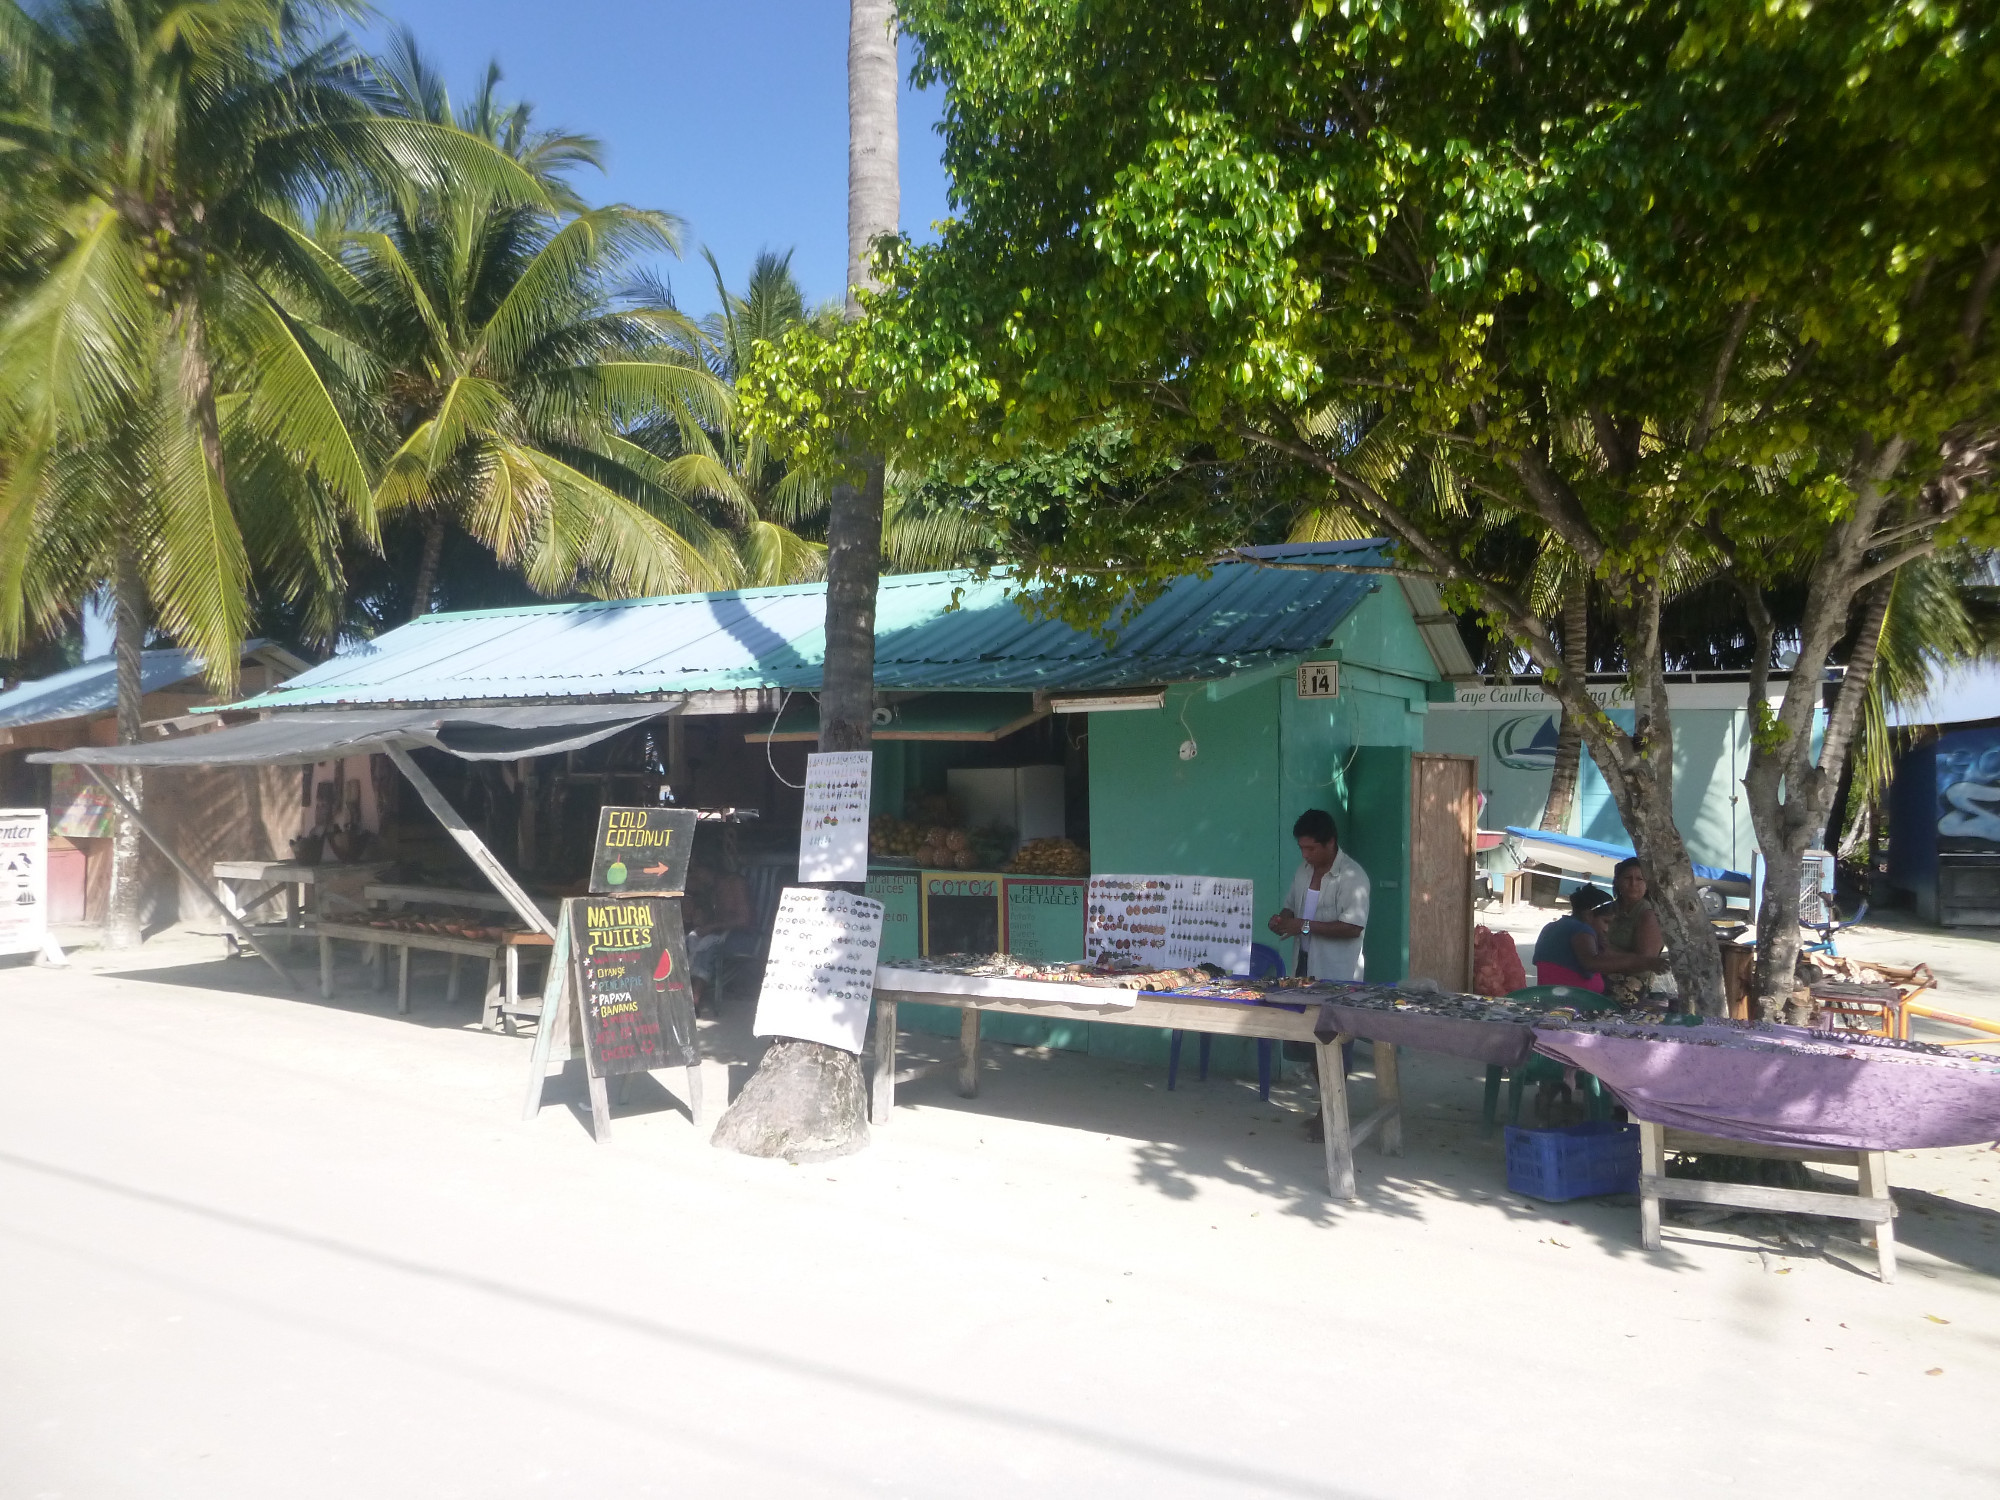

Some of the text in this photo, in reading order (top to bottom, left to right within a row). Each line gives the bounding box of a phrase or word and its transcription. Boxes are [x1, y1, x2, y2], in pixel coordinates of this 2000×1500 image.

[1311, 675, 1329, 693] 14
[608, 811, 648, 829] COLD
[605, 829, 674, 847] COCONUT
[1022, 885, 1064, 896] FRUITS
[1009, 894, 1079, 906] VEGETABLES
[587, 905, 654, 928] NATURAL
[599, 992, 632, 1006] PAPAYA
[600, 1002, 638, 1018] BANANAS
